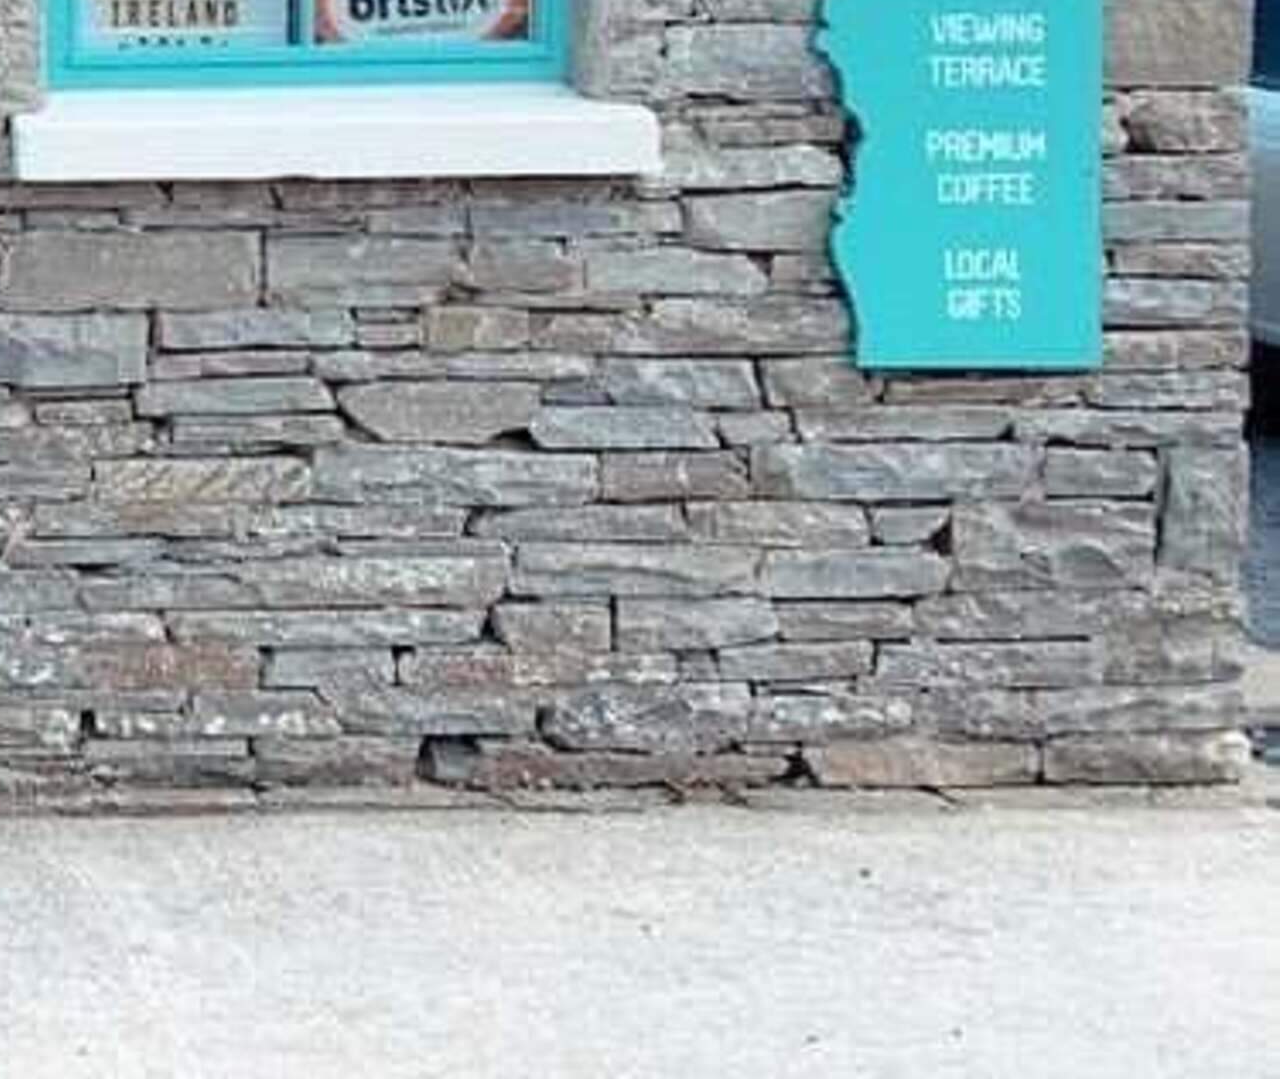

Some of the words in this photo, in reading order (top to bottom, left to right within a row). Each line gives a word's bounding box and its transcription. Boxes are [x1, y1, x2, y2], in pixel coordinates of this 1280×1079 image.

[111, 0, 238, 28] IRELAND
[931, 12, 1046, 45] VIEWING
[929, 55, 1046, 87] TERRACE
[925, 128, 1047, 162] PREMIUM
[937, 173, 1035, 205] COFFEE
[944, 249, 1020, 281] LOCAL
[947, 287, 1022, 320] GIFTS
